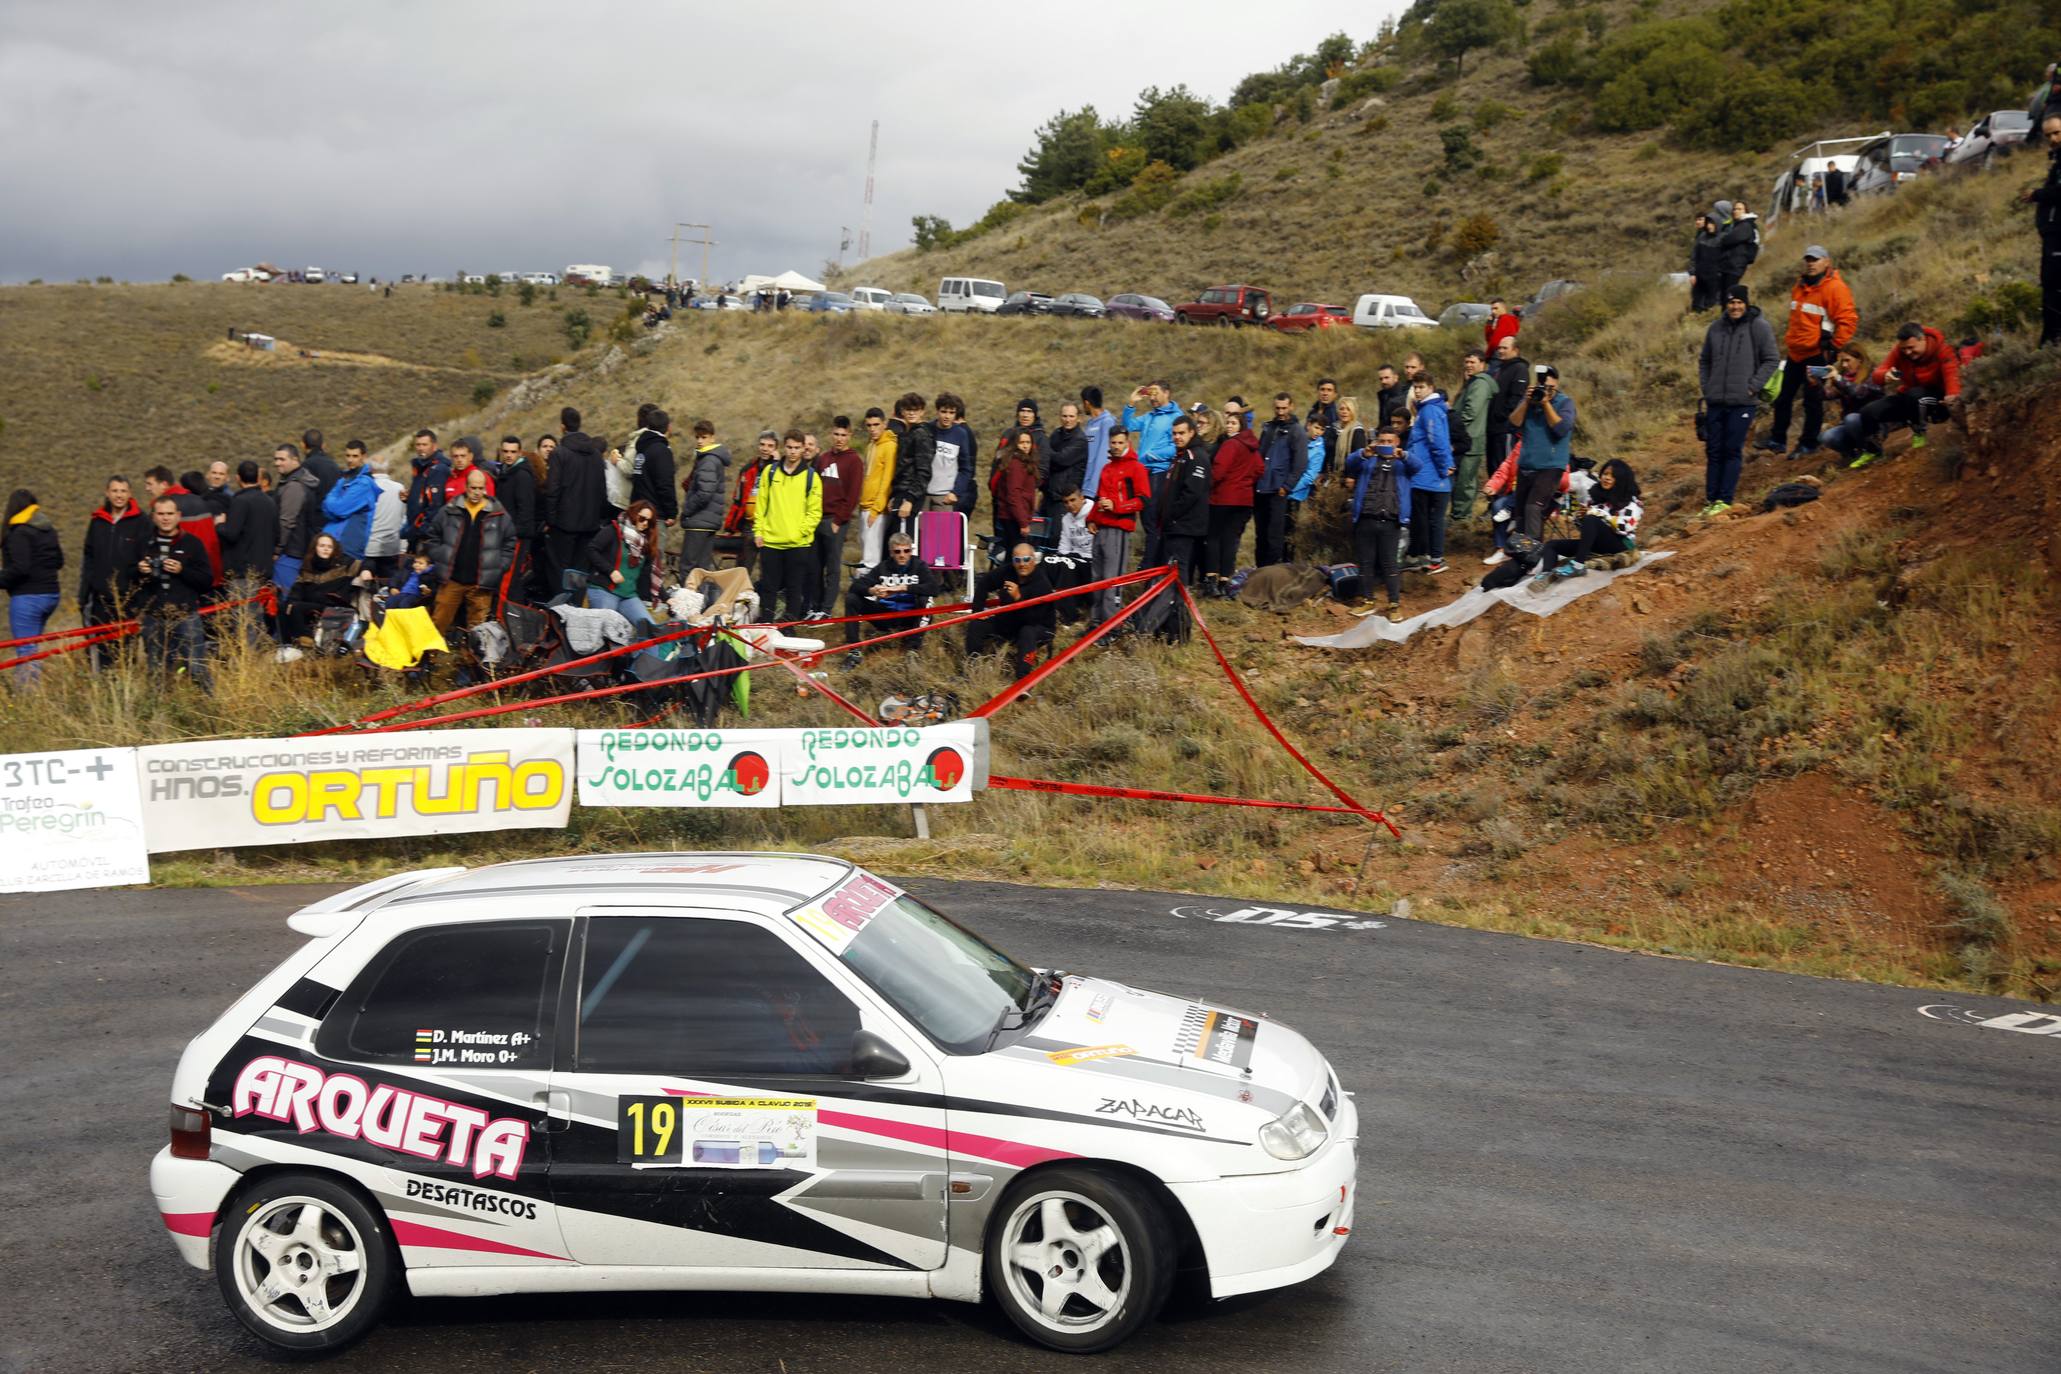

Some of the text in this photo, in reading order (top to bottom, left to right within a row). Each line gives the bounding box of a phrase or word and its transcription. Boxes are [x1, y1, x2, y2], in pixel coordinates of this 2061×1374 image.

[147, 745, 463, 774] CONSTRUCCIONES Y REFORMAS
[600, 732, 723, 762] REDONDO
[802, 729, 921, 761] REDONDO
[150, 750, 565, 826] HNOS. ORTUÑO
[588, 763, 745, 802] SOLOZABAL
[792, 759, 943, 798] SOLOZABAL
[451, 1030, 508, 1045] Martínez
[461, 1048, 495, 1063] Moro
[231, 1055, 529, 1181] ARQUETA
[627, 1102, 676, 1156] 19
[406, 1179, 536, 1220] DESATASCOS
